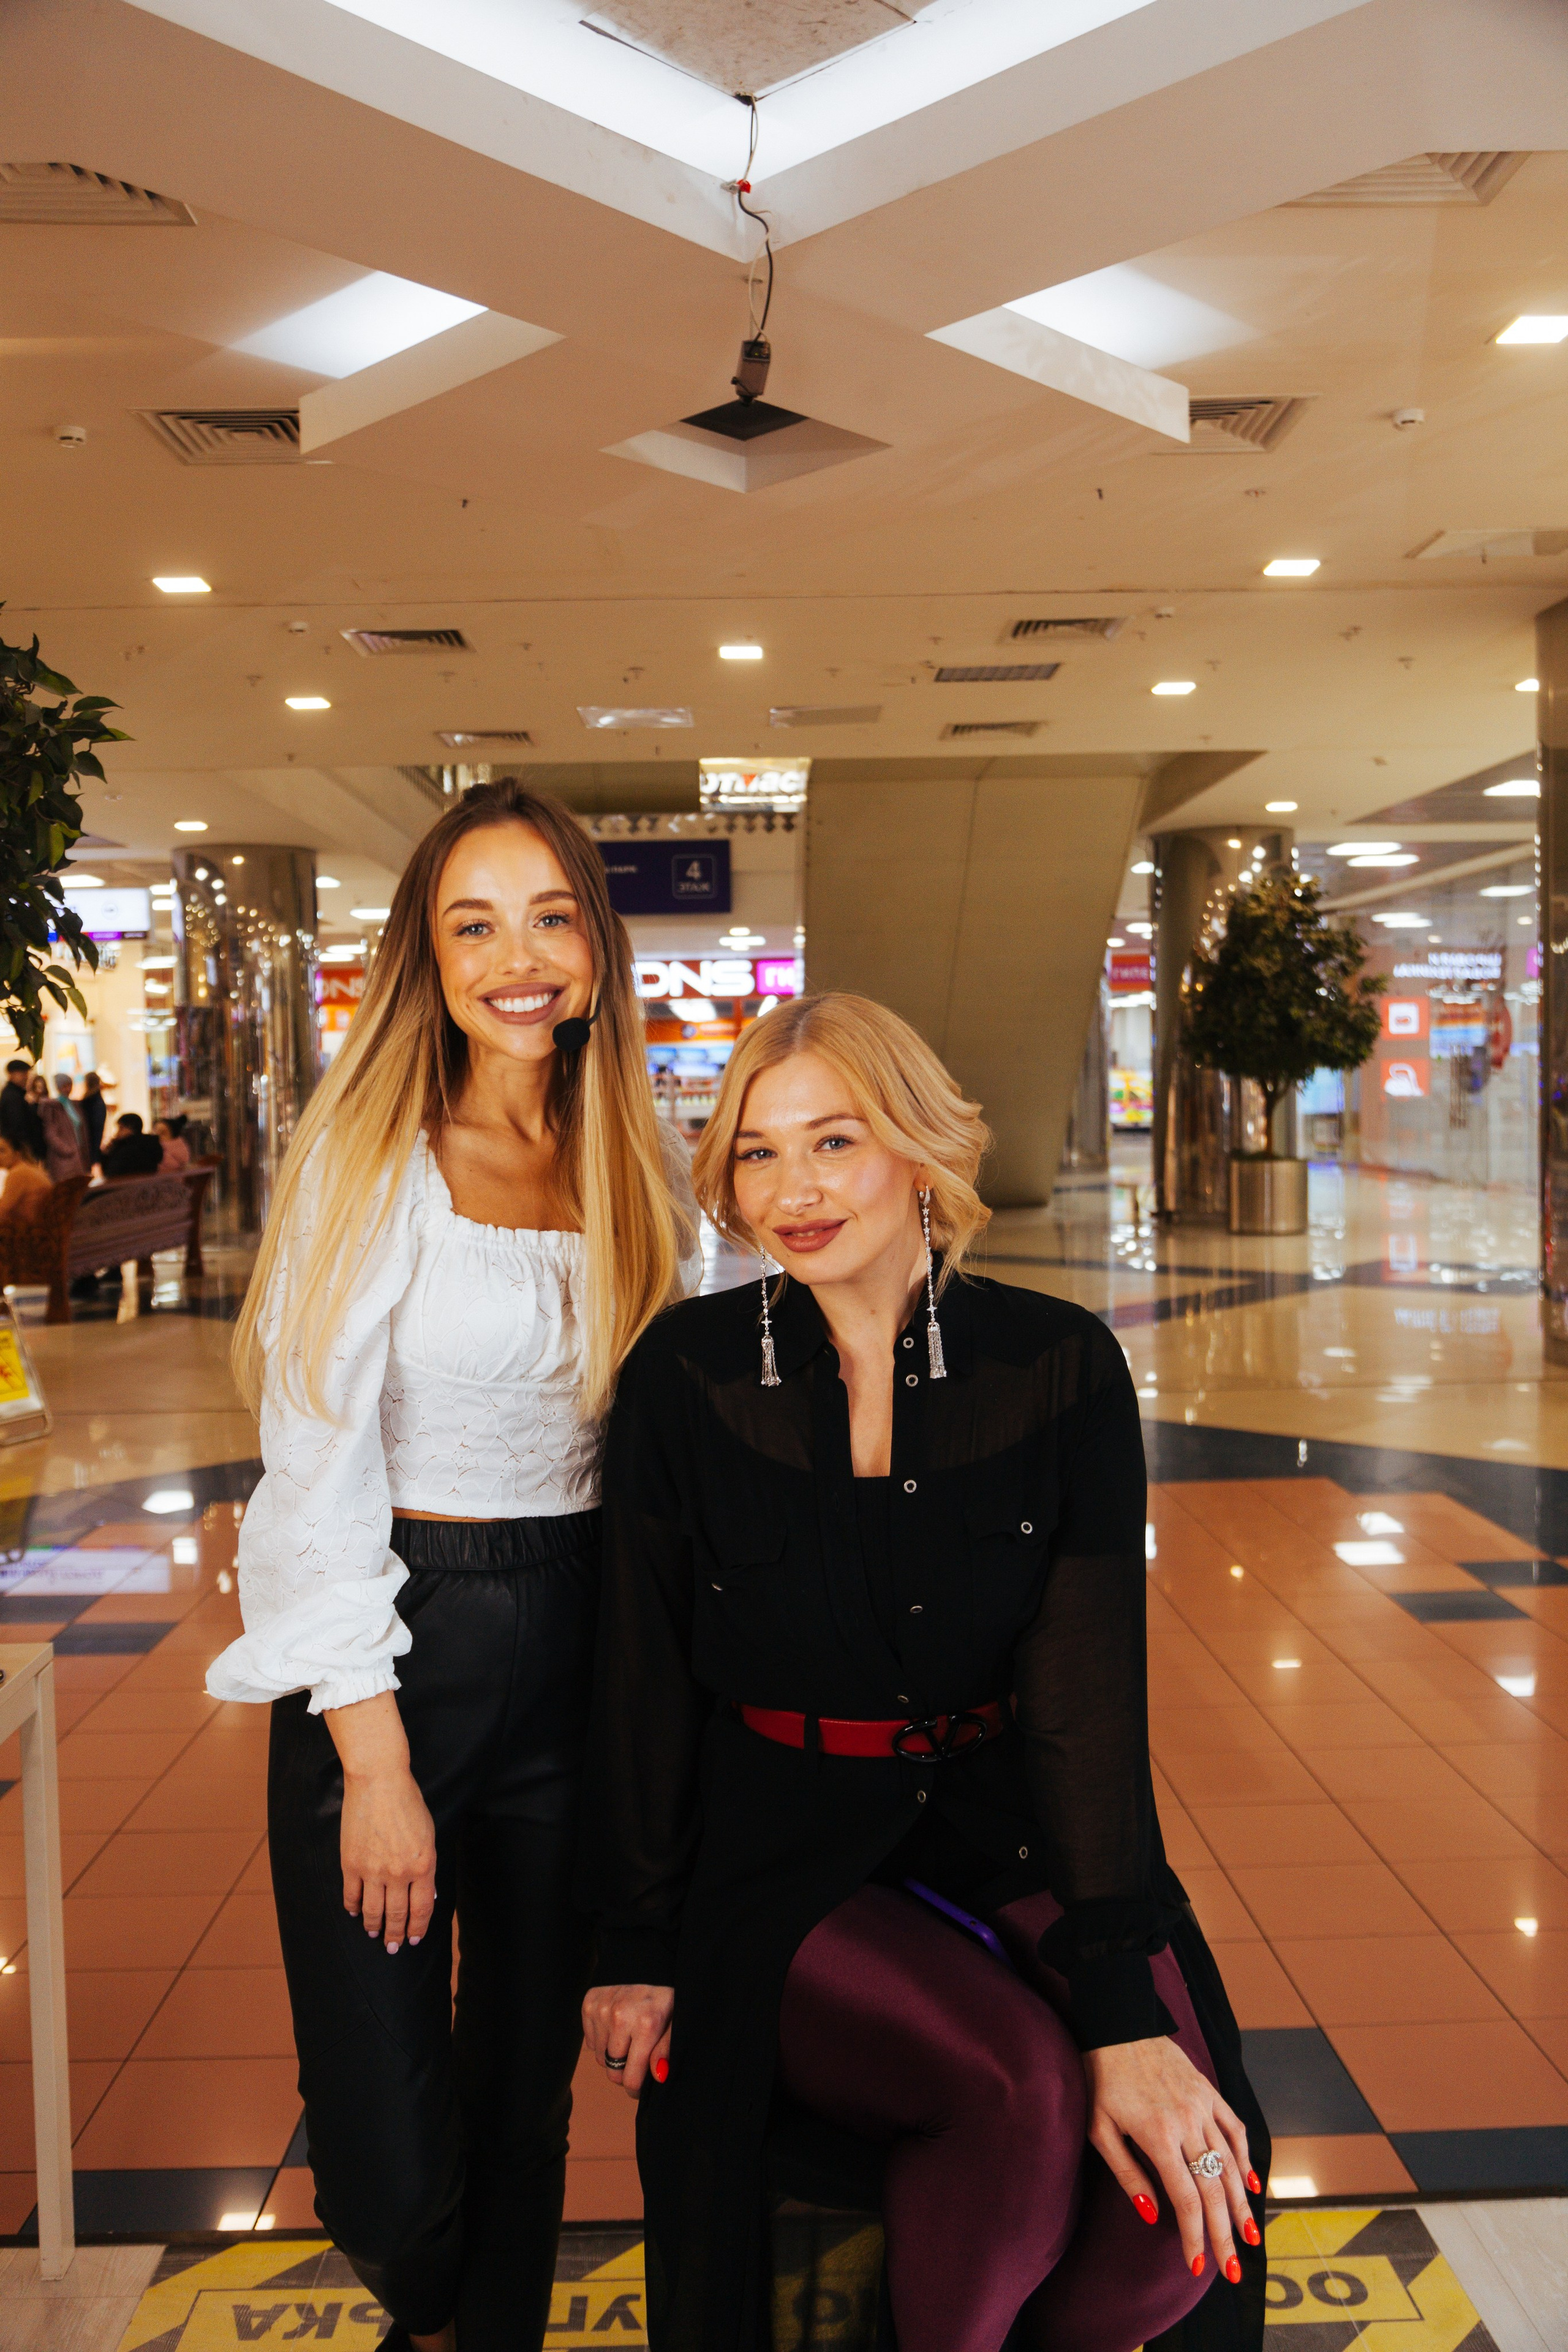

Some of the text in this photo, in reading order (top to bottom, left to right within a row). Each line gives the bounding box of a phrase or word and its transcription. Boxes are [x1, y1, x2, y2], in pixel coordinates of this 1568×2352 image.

[685, 860, 702, 880] 4
[678, 881, 710, 893] ЭТАЖ
[633, 960, 755, 997] DNS
